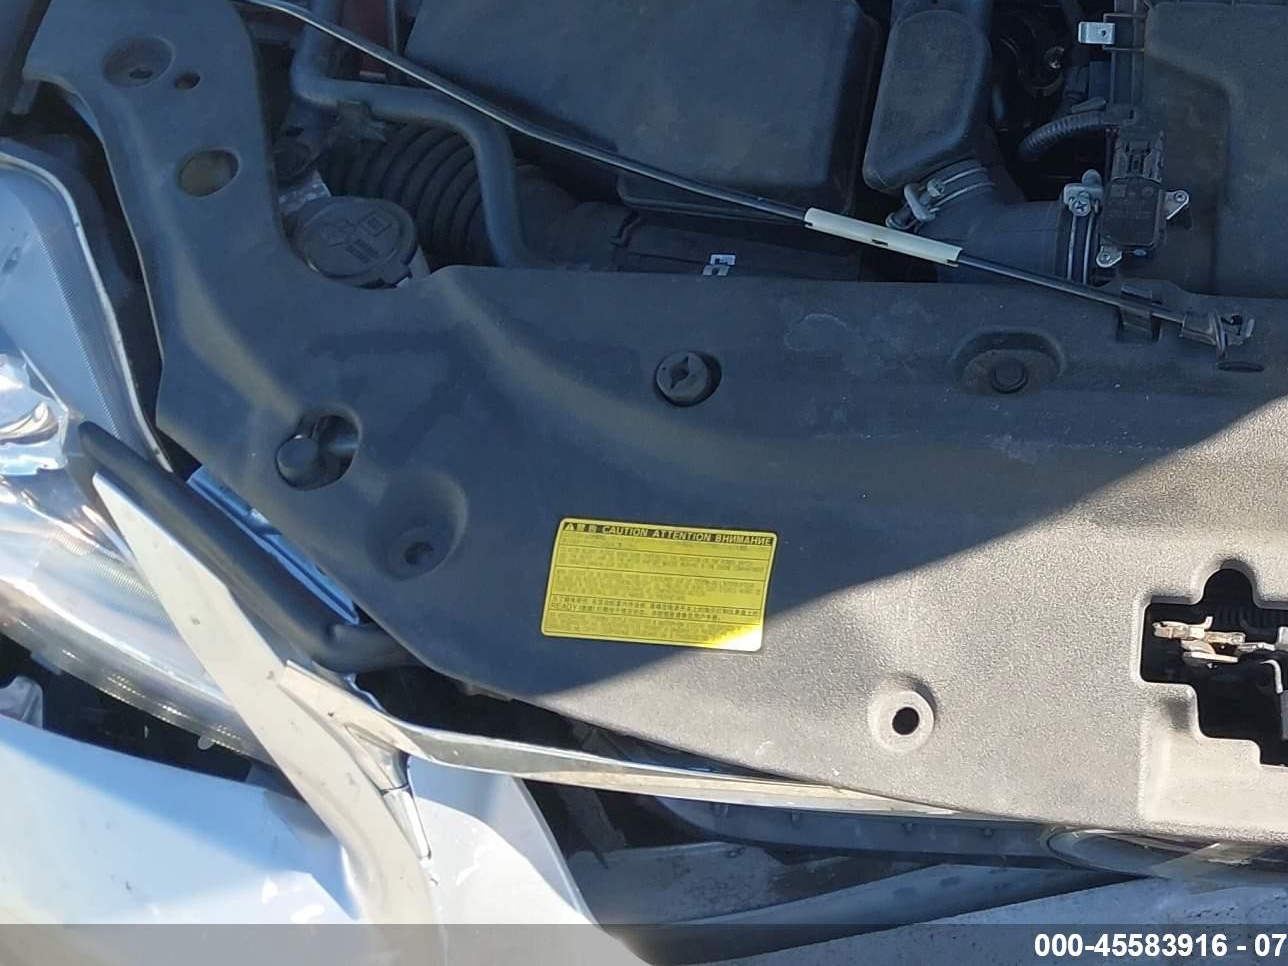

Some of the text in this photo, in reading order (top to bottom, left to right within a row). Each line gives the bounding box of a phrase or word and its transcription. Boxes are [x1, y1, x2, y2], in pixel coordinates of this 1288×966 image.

[602, 525, 649, 538] CAUTION
[652, 529, 711, 543] ATTENTION
[715, 534, 773, 546] ВНИМАНИЕ
